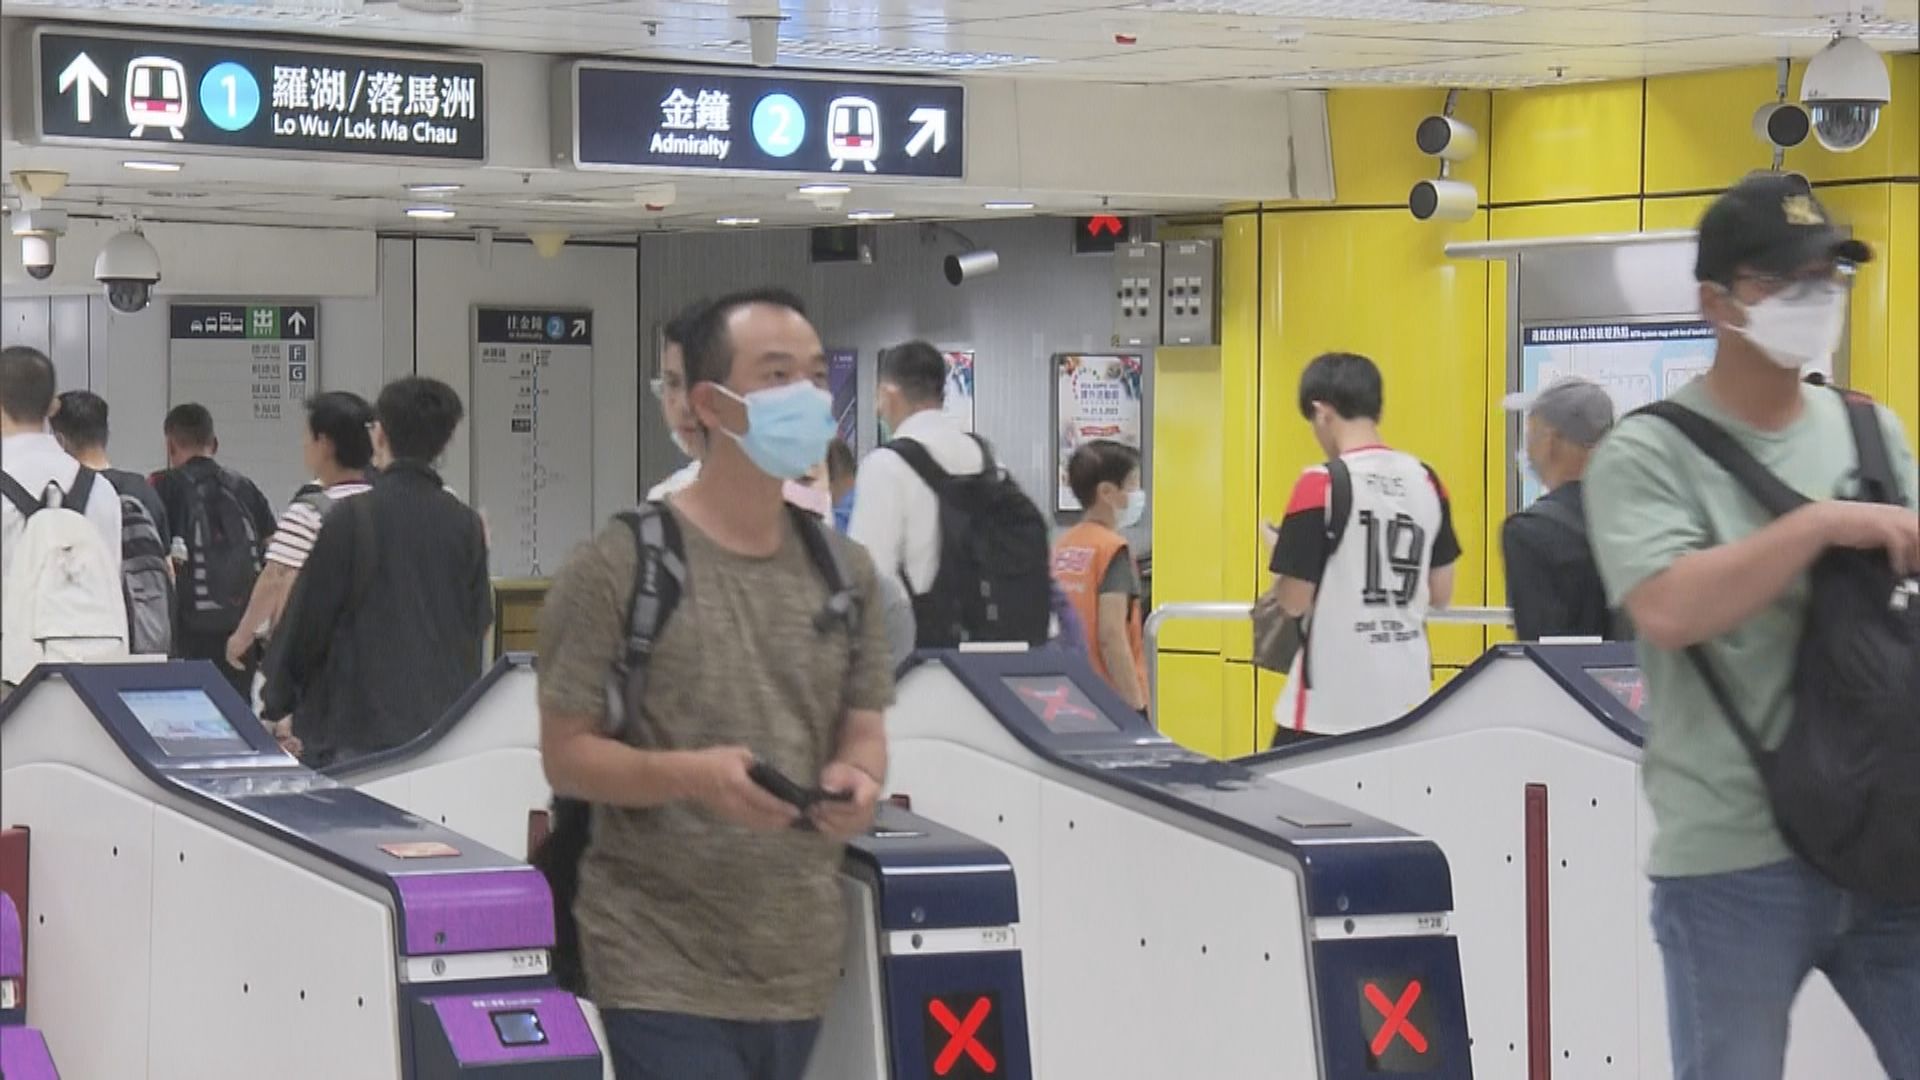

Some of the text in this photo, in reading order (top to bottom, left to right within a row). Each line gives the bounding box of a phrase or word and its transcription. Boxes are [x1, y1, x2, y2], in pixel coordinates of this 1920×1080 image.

[220, 74, 237, 119] 1
[272, 65, 476, 121] 羅湖/落馬洲
[660, 87, 731, 132] 金鐘
[767, 103, 792, 146] 2
[273, 112, 296, 135] Lo
[299, 114, 330, 136] Wu
[344, 117, 377, 140] Lok
[381, 120, 409, 142] Ma
[412, 121, 459, 144] Chau
[650, 132, 731, 161] Admiralty
[253, 309, 274, 328] 出
[551, 319, 561, 337] 2
[292, 348, 302, 360] F
[292, 367, 304, 380] G
[1358, 510, 1426, 607] 19
